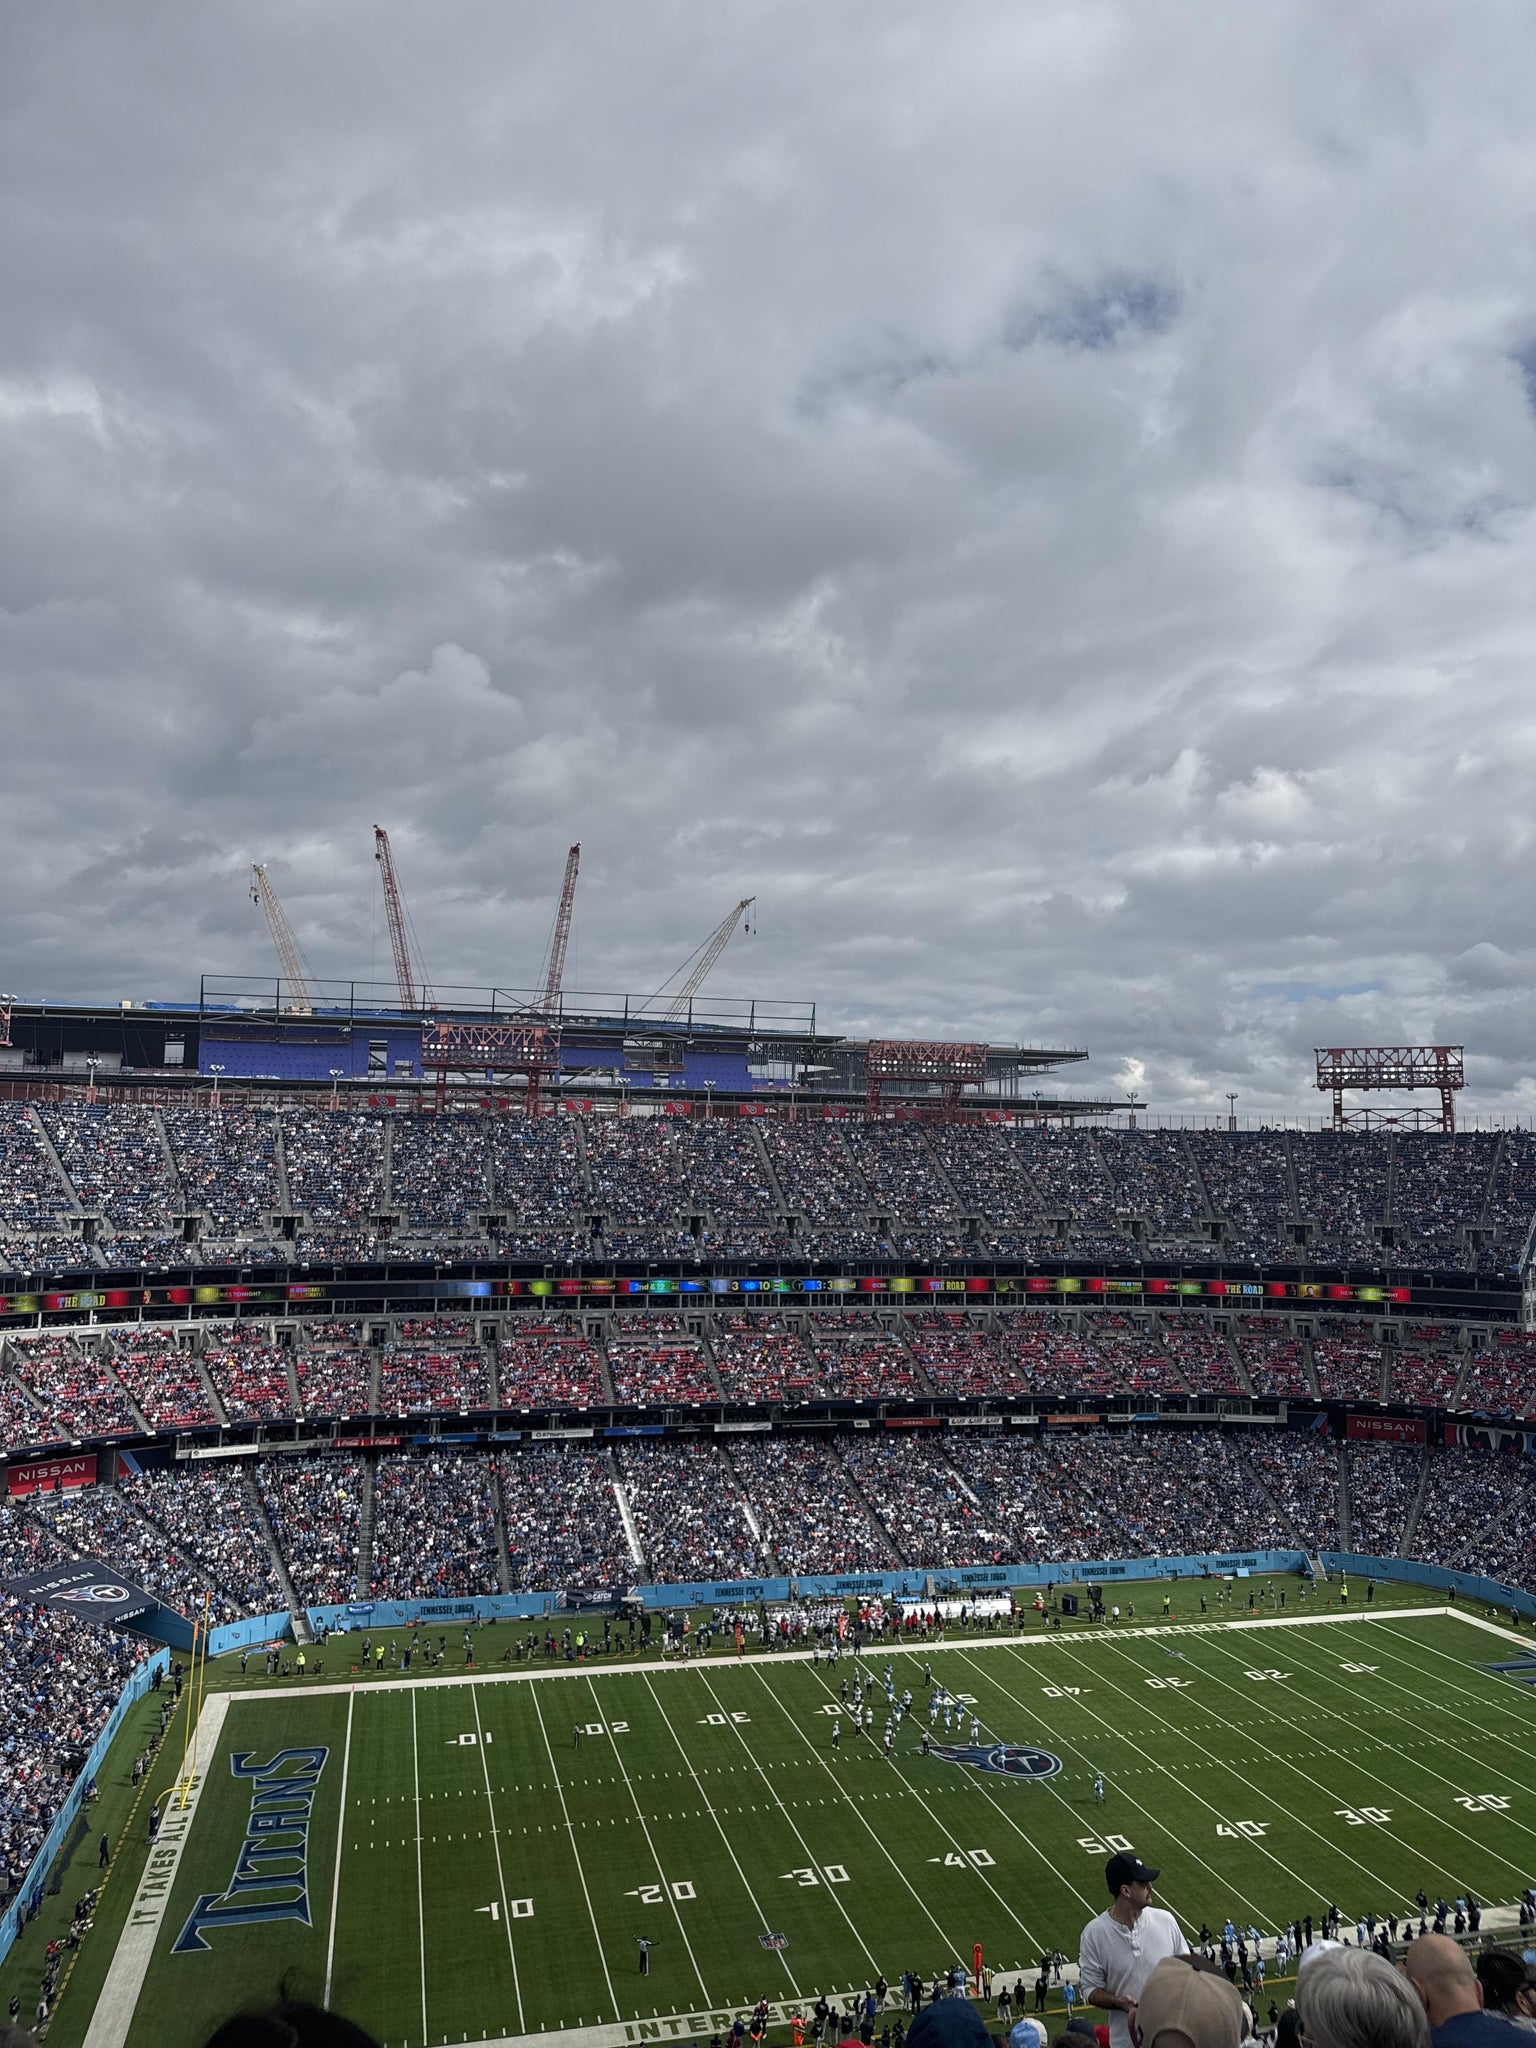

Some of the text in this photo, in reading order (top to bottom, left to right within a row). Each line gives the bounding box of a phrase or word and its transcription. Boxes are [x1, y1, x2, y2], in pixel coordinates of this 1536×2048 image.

[732, 1282, 739, 1290] 3
[759, 1281, 770, 1290] 10
[929, 1282, 965, 1291] THE ROAD
[1225, 1284, 1263, 1295] THE ROAD
[57, 1296, 78, 1309] THE
[1356, 1420, 1415, 1432] NISSAN
[18, 1462, 86, 1482] NISSAN
[1081, 1566, 1108, 1577] TENNESSEE
[1215, 1559, 1240, 1569] TENNESSEE
[28, 1571, 95, 1595] NISSAN
[836, 1579, 865, 1589] TENNESSEE
[961, 1573, 989, 1583] TENNESSEE
[593, 1592, 612, 1600] CATCH
[714, 1587, 744, 1597] TENNESSEE
[114, 1607, 146, 1623] NISSAN
[420, 1605, 452, 1615] TENNESSEE
[1045, 1622, 1228, 1642] INTERCEPT CANCER
[706, 1711, 751, 1725] 30
[585, 1721, 630, 1735] 20
[459, 1732, 493, 1745] 10
[1453, 1794, 1512, 1812] 20
[1333, 1807, 1392, 1826] 30
[157, 1816, 189, 1842] ALL
[1216, 1820, 1267, 1839] 40
[170, 1746, 330, 1955] TITANS
[1076, 1834, 1135, 1855] 50
[944, 1849, 997, 1868] 40
[139, 1848, 177, 1902] TAKES
[791, 1864, 851, 1887] 30
[638, 1881, 697, 1904] 20
[490, 1898, 535, 1921] 10
[131, 1910, 160, 1926] IT
[624, 2000, 829, 2042] INTERCEP
